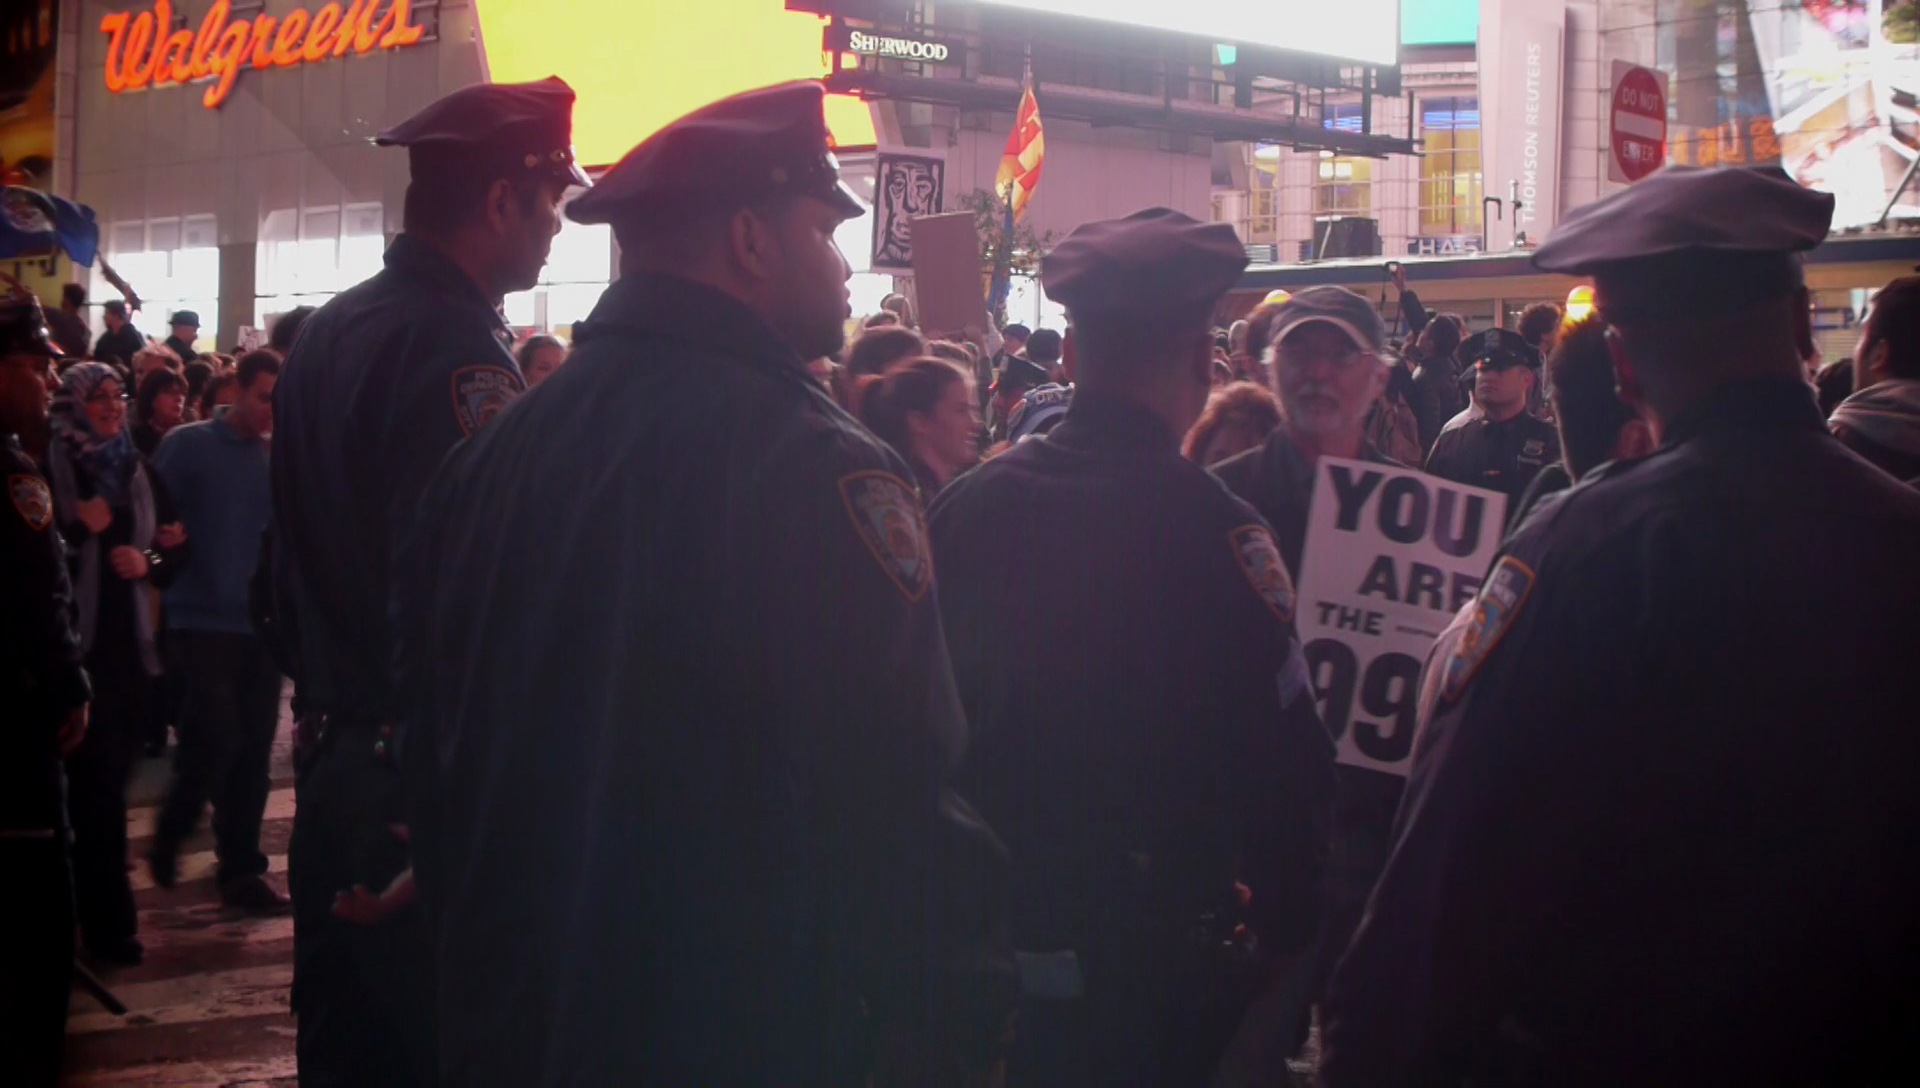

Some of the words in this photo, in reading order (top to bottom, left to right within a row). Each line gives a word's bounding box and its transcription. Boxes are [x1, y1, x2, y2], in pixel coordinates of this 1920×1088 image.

[101, 0, 425, 108] Walgreens
[849, 31, 948, 60] SHERWOOD
[1526, 43, 1542, 126] REUTERS
[1622, 86, 1637, 106] DO
[1640, 91, 1659, 111] NOT
[1522, 131, 1539, 223] THOMSON
[1622, 140, 1655, 162] ENTER
[1328, 464, 1486, 558] YOU
[1316, 601, 1384, 636] THE
[1303, 637, 1422, 763] 99
